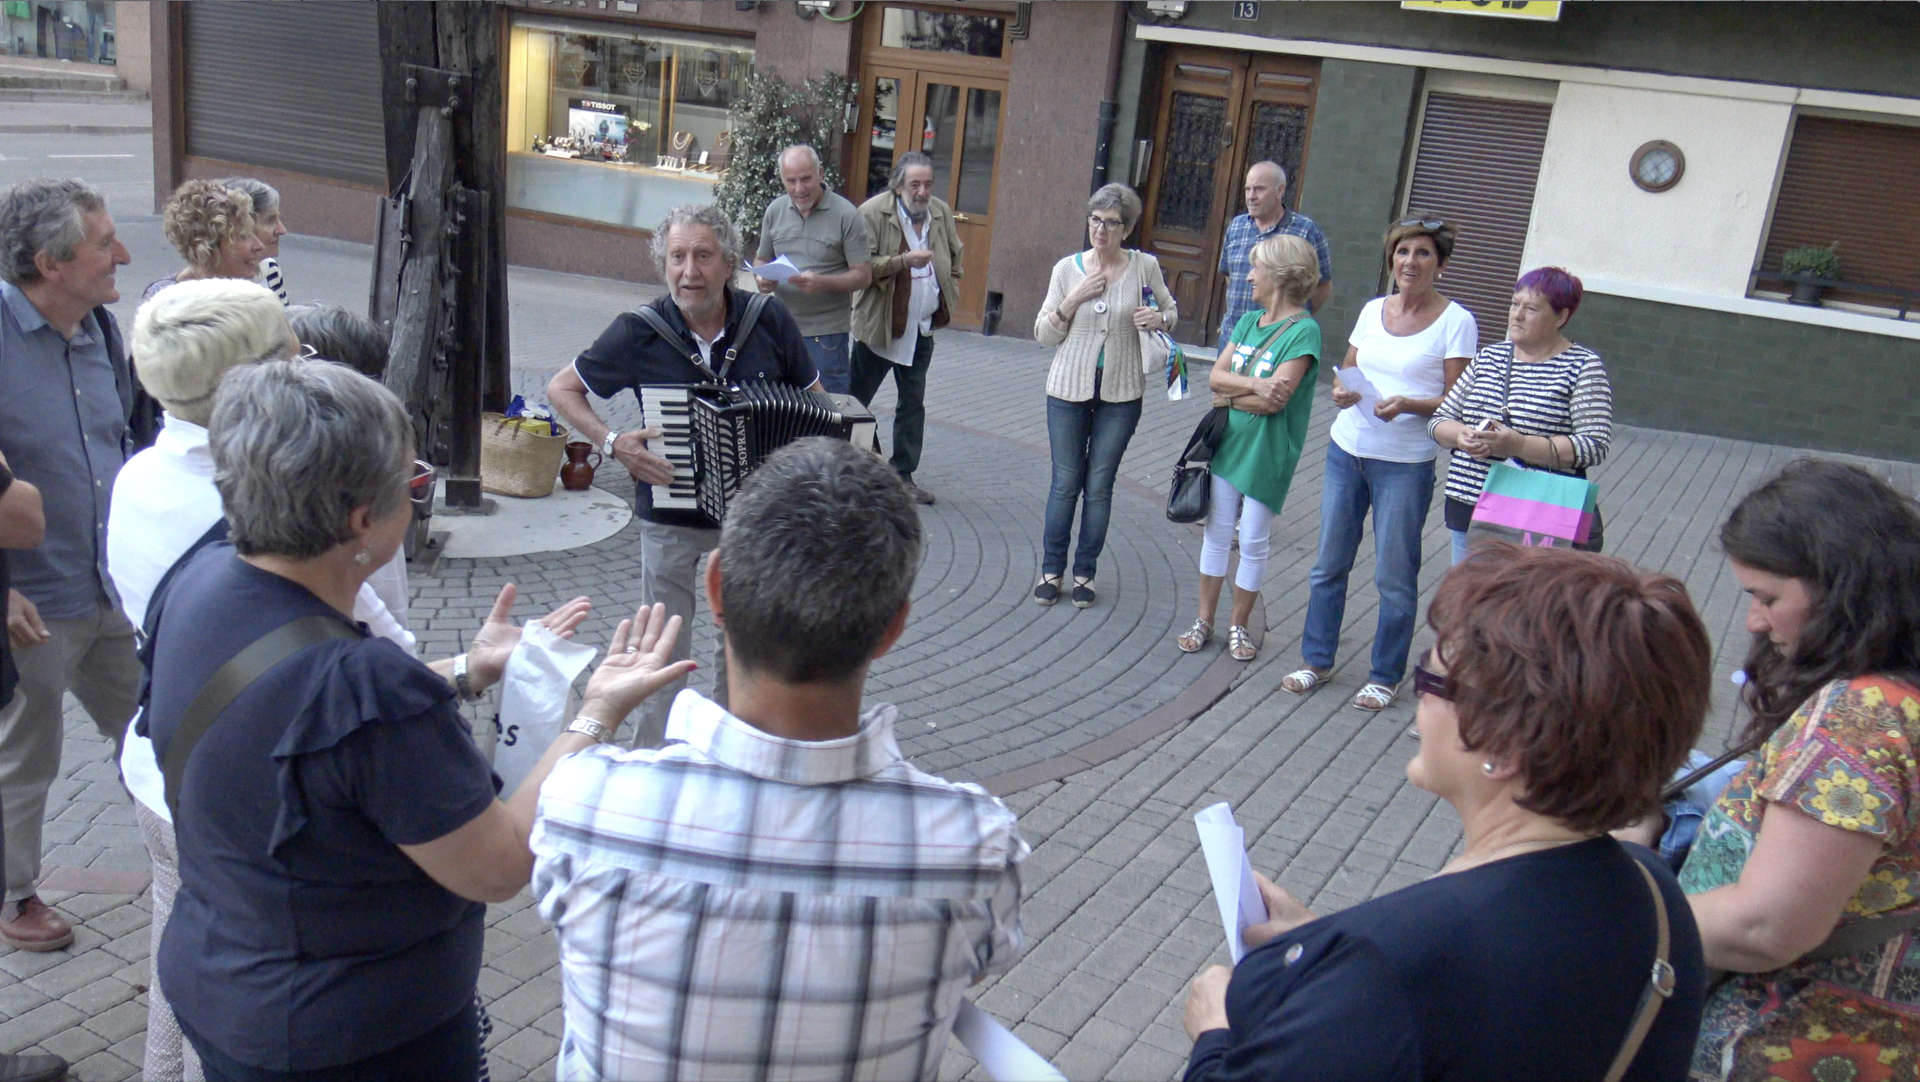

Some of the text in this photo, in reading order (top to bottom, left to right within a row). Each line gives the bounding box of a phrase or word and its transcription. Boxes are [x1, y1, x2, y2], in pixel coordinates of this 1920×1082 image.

[1239, 2, 1254, 18] 13
[591, 101, 617, 111] TISSOT
[736, 415, 748, 466] SOPRANI
